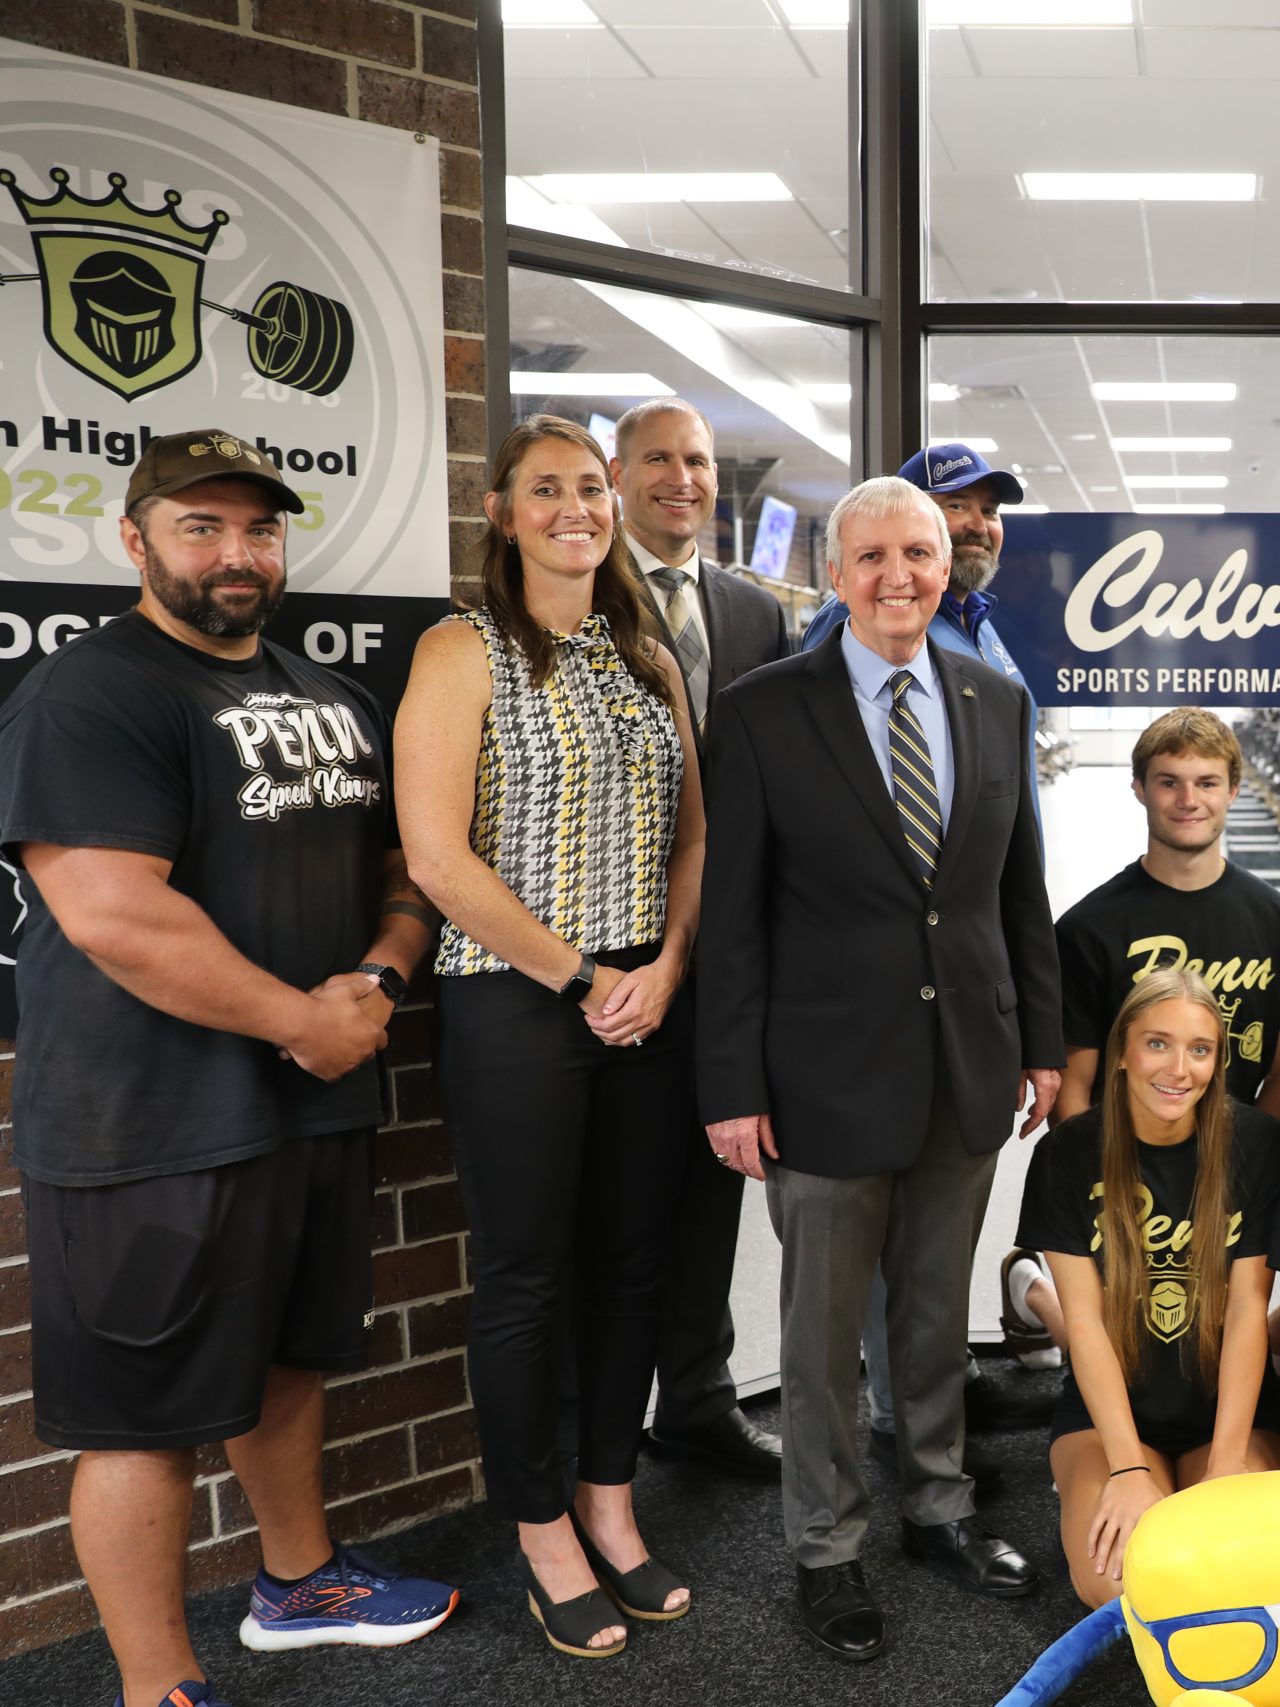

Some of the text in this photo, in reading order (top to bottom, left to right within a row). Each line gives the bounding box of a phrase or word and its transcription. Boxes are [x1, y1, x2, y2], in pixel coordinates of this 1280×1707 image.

[256, 437, 357, 476] hool
[0, 611, 384, 665] OG OF
[1057, 667, 1150, 693] SPORTS
[240, 766, 381, 819] Speed Kings
